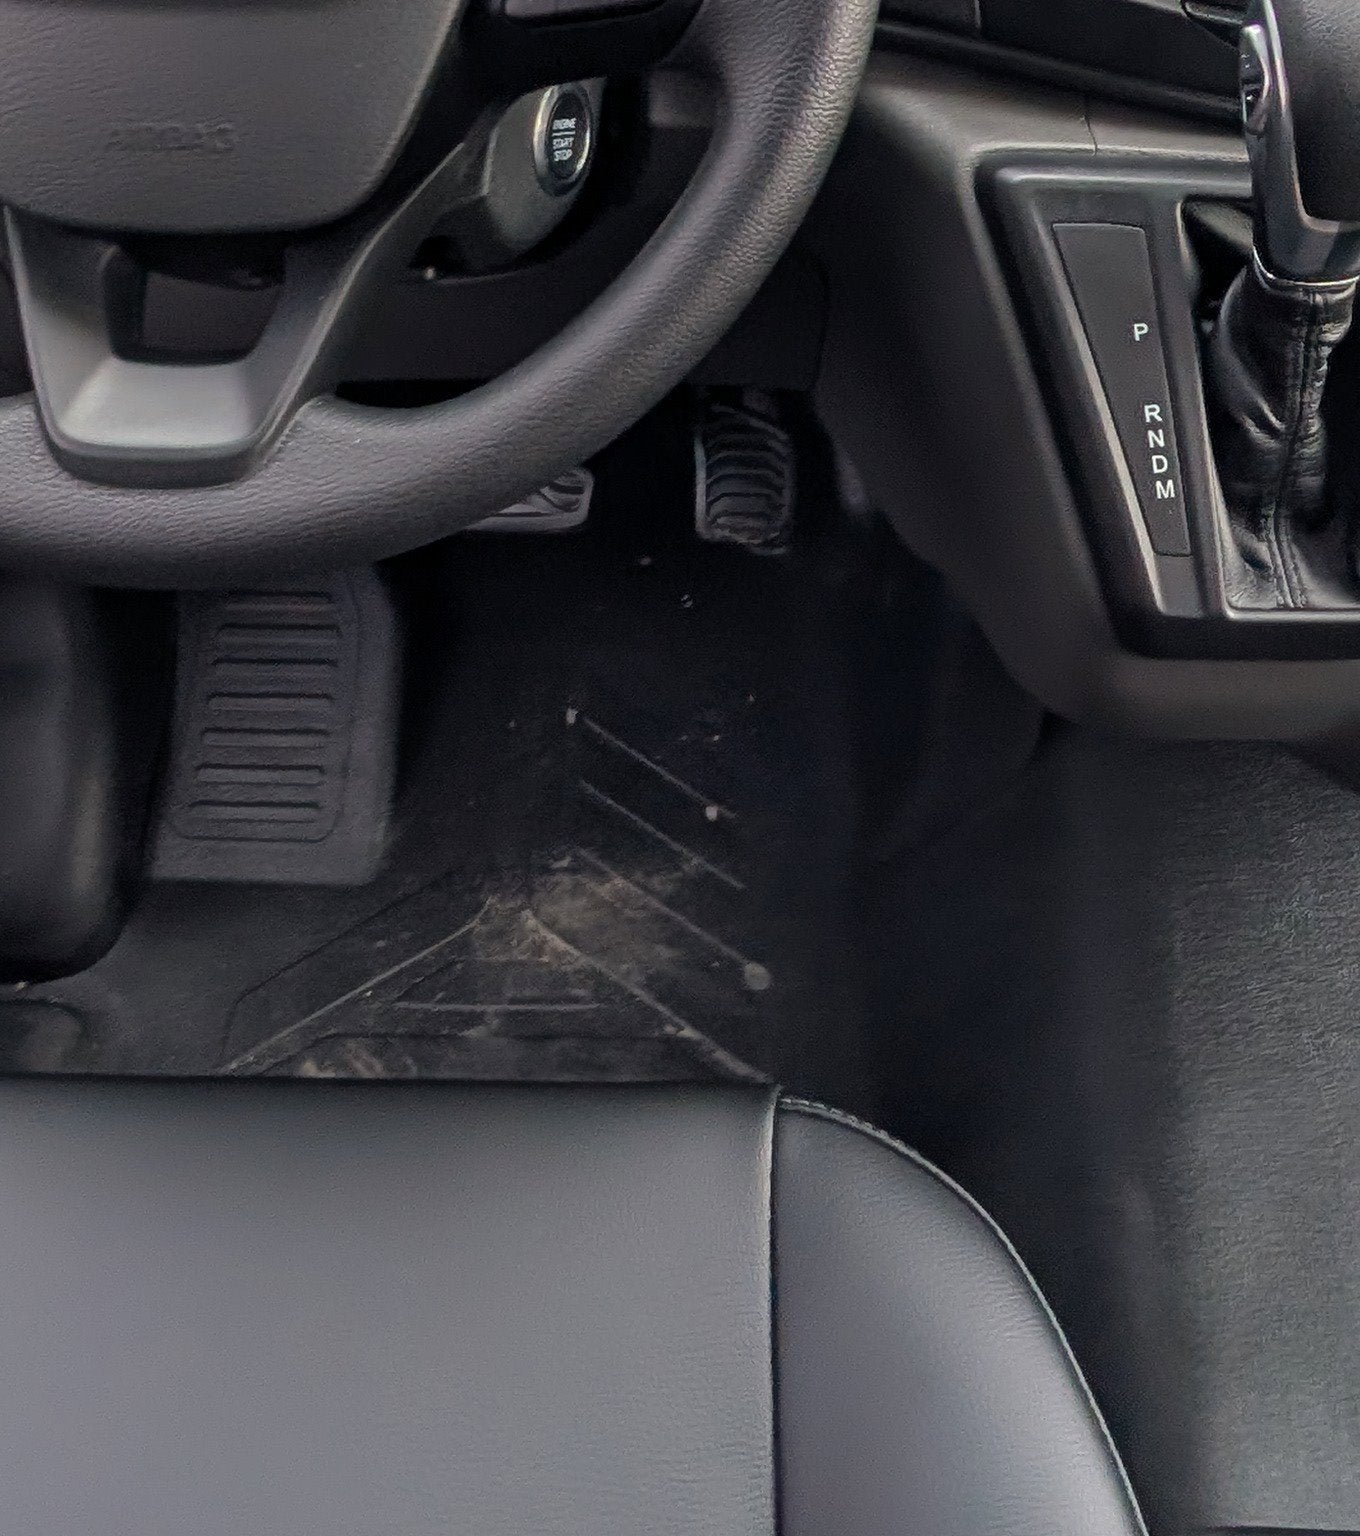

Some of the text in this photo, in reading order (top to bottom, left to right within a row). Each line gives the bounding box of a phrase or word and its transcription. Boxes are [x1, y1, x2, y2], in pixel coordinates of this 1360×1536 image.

[1134, 323, 1149, 341] P
[1143, 404, 1162, 422] R
[1147, 430, 1165, 447] N
[1151, 455, 1168, 473] D
[1155, 480, 1175, 499] M
